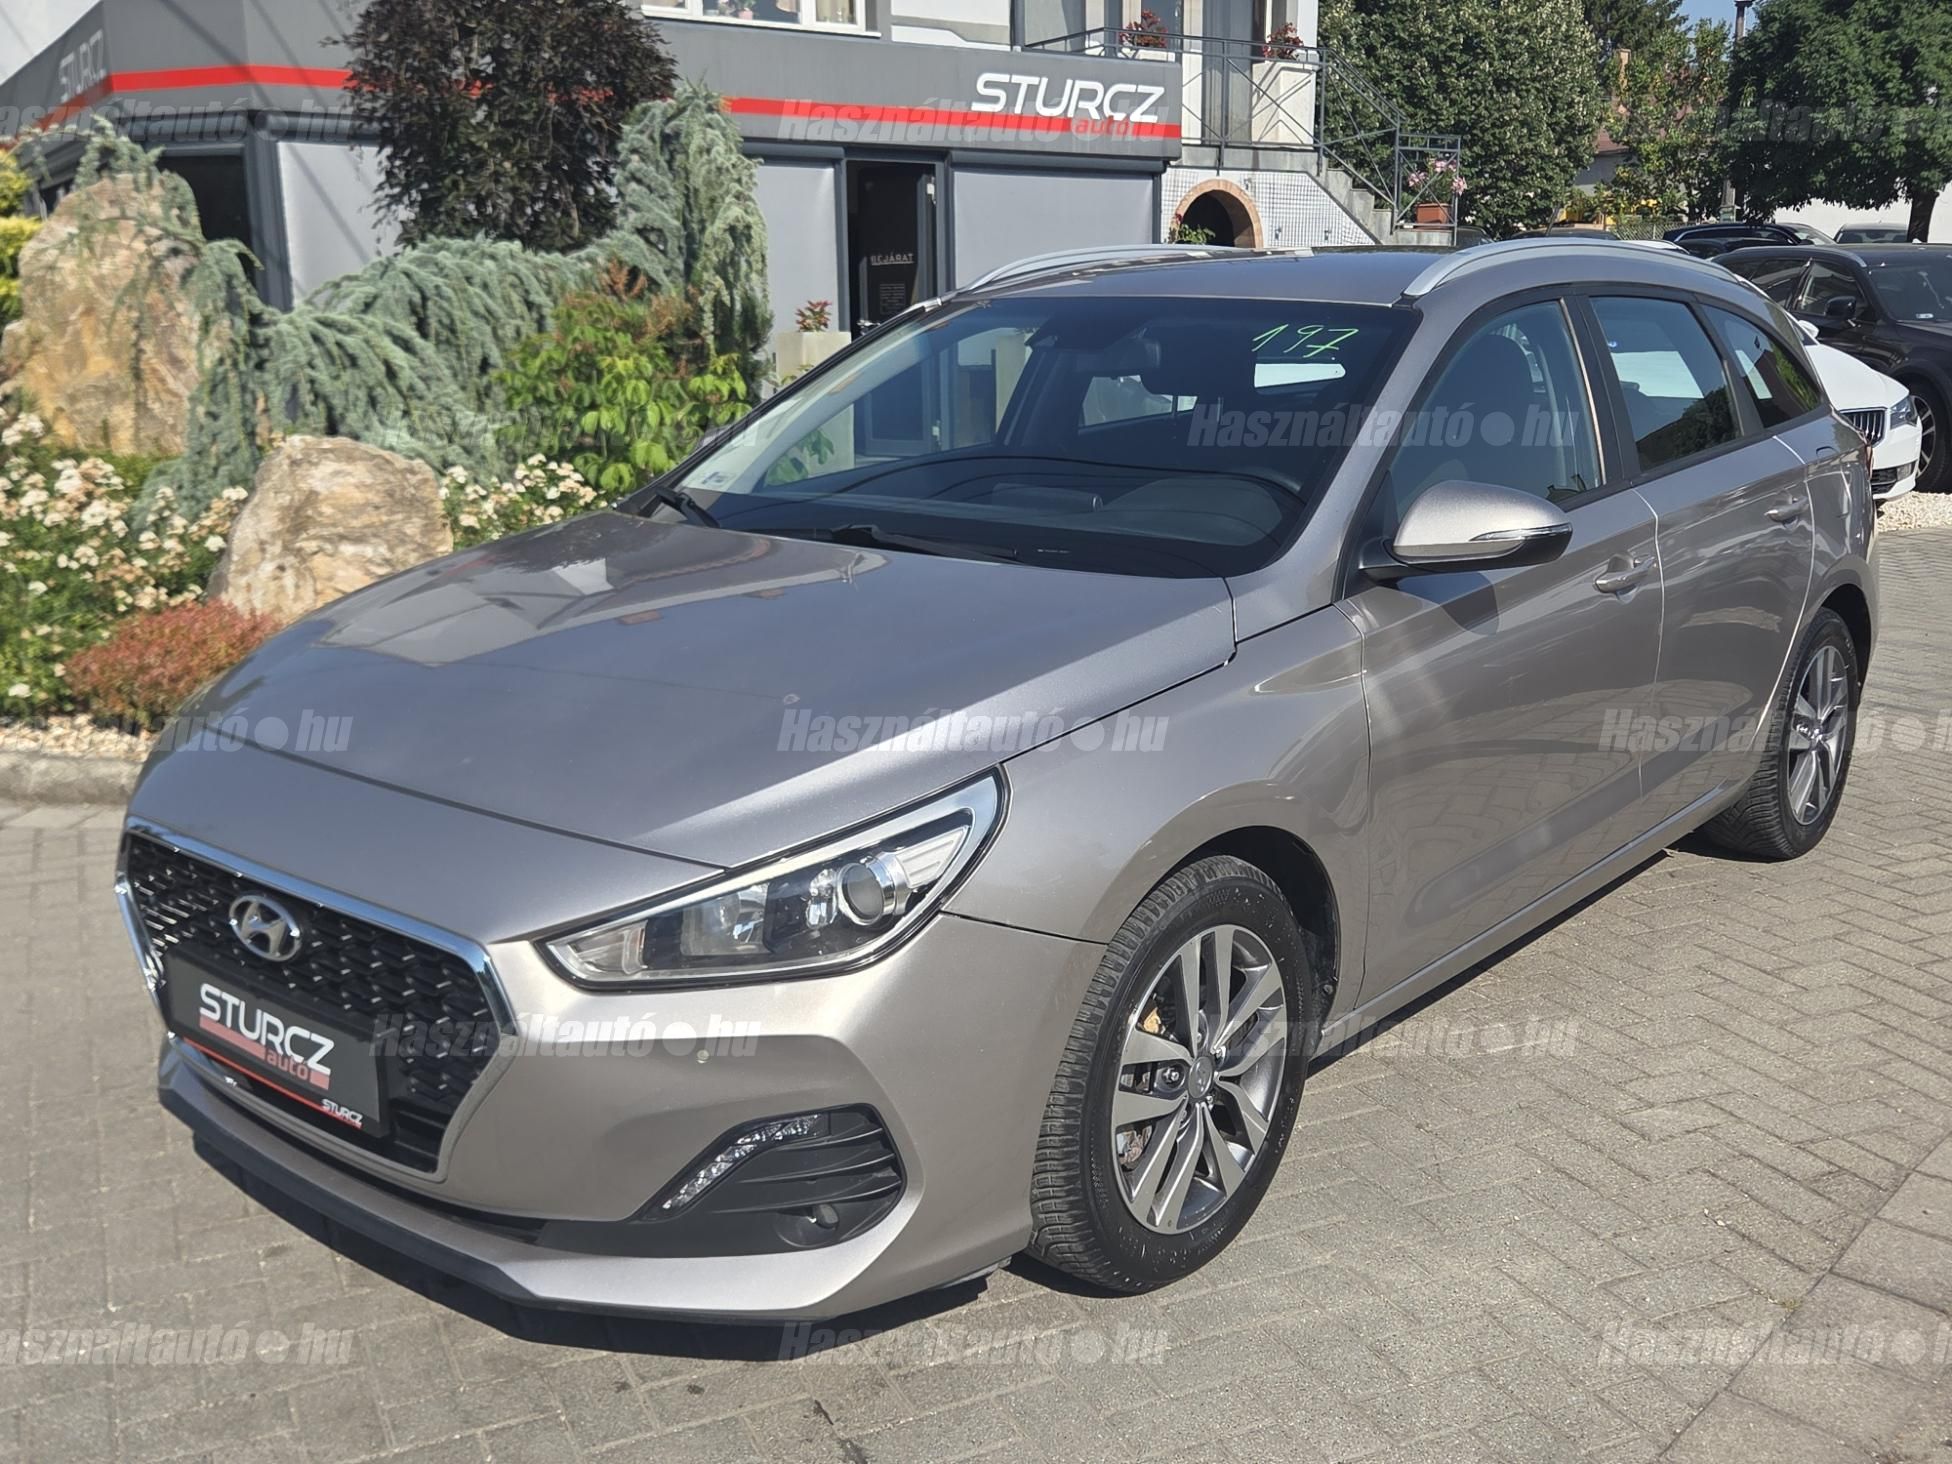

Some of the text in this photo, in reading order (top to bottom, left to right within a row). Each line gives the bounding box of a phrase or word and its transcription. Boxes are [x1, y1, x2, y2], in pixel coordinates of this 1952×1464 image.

[971, 72, 1165, 123] STURCZ
[1251, 323, 1359, 358] 197
[200, 983, 335, 1076] STURCZ
[266, 1050, 310, 1081] auto
[321, 1098, 363, 1127] STURCZ
